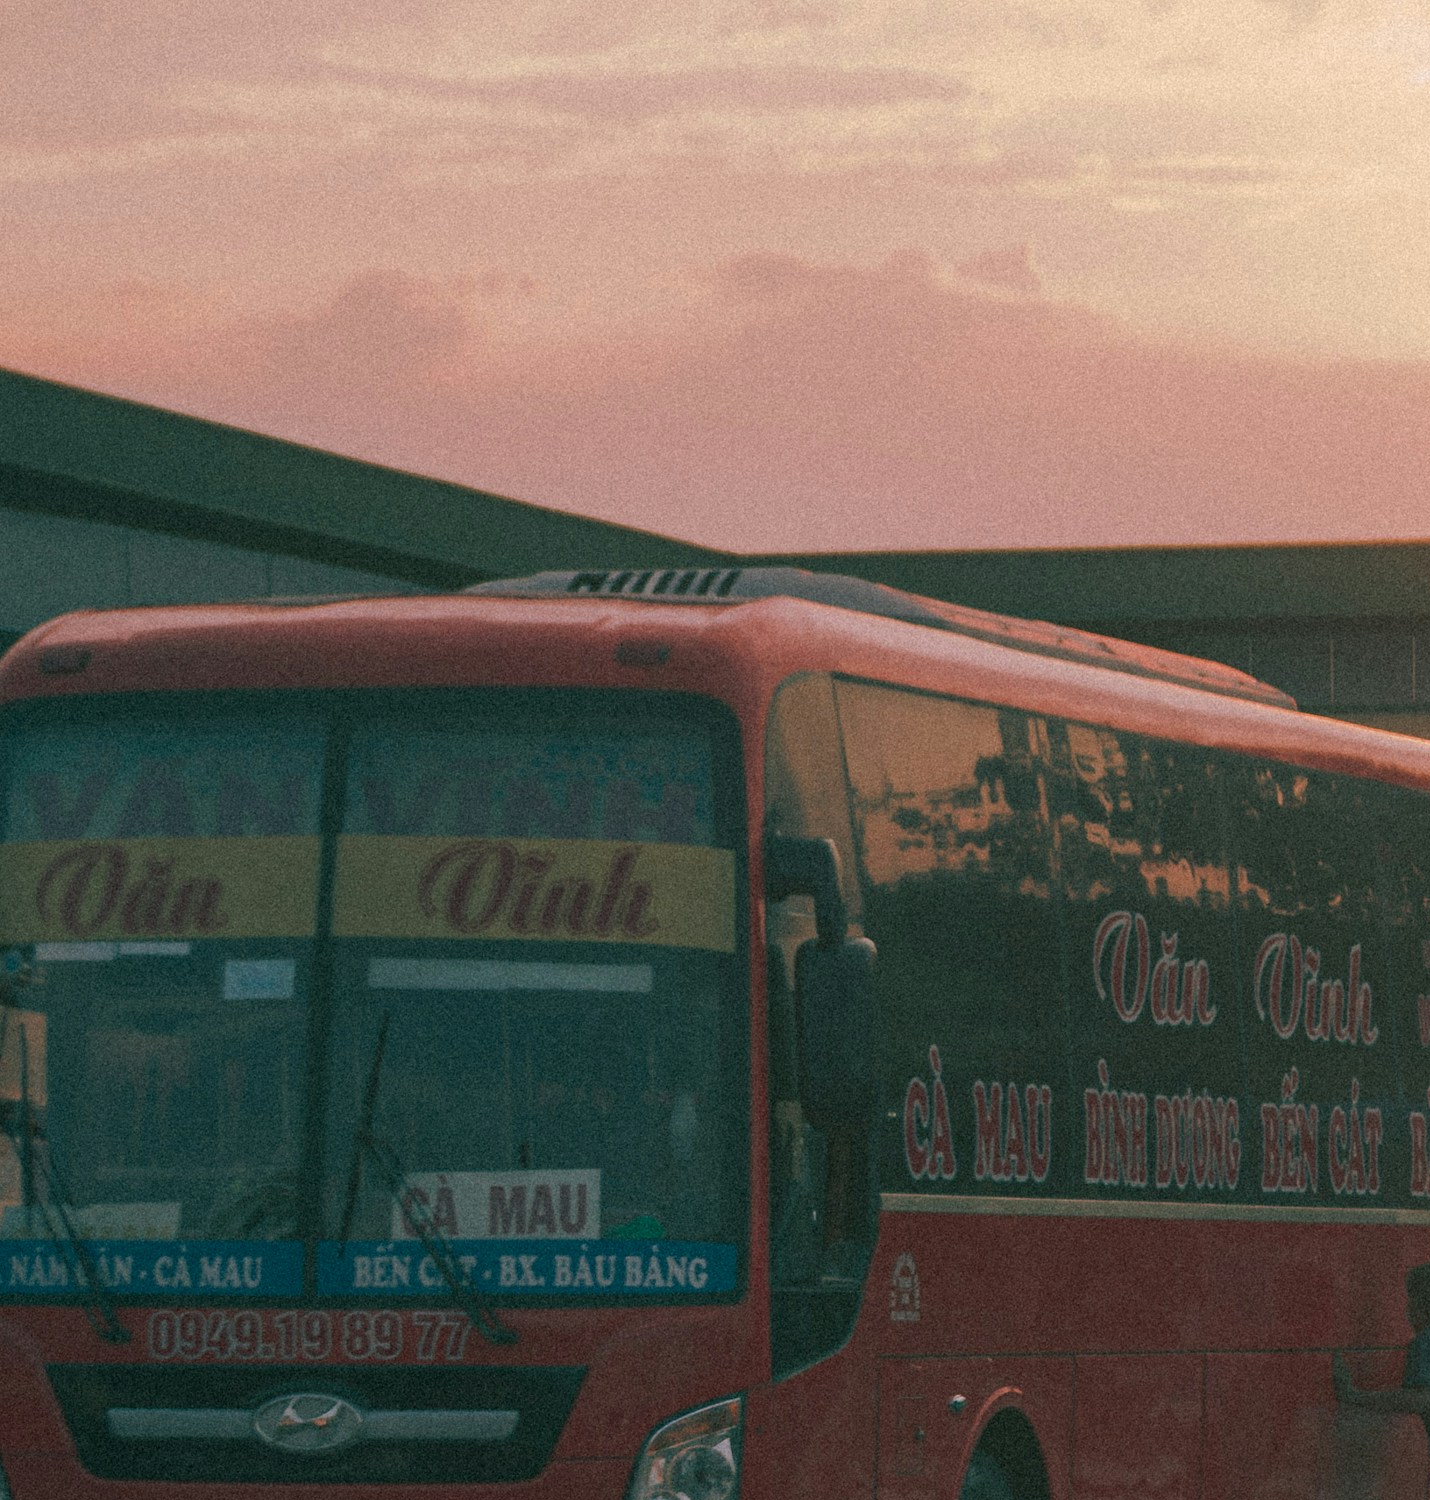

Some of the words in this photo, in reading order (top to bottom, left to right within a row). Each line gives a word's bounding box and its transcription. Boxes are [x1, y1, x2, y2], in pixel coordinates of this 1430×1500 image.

[36, 844, 229, 936] Văn
[418, 839, 661, 938] Vĩnh
[1093, 911, 1217, 1026] Văn
[1253, 932, 1379, 1046] Vĩnh
[904, 1043, 957, 1181] CÀ
[972, 1079, 1053, 1183] MAU
[1084, 1057, 1148, 1188] BÌNH
[1155, 1087, 1242, 1190] DƯƠNG
[1261, 1065, 1319, 1194] BẾN
[1328, 1077, 1383, 1195] CÁT
[402, 1173, 459, 1238] CÀ
[488, 1182, 588, 1236] MAU
[10, 1246, 69, 1287] NĂM
[74, 1246, 134, 1287] ĂN
[154, 1244, 192, 1288] CÀ
[199, 1255, 263, 1288] MAU
[353, 1244, 411, 1288] BẾN
[500, 1255, 545, 1288] BX.
[555, 1244, 617, 1288] BÀU
[624, 1245, 709, 1289] BÀNG
[149, 1310, 332, 1361] 0949.19
[342, 1310, 403, 1362] 89
[413, 1310, 472, 1362] 77
